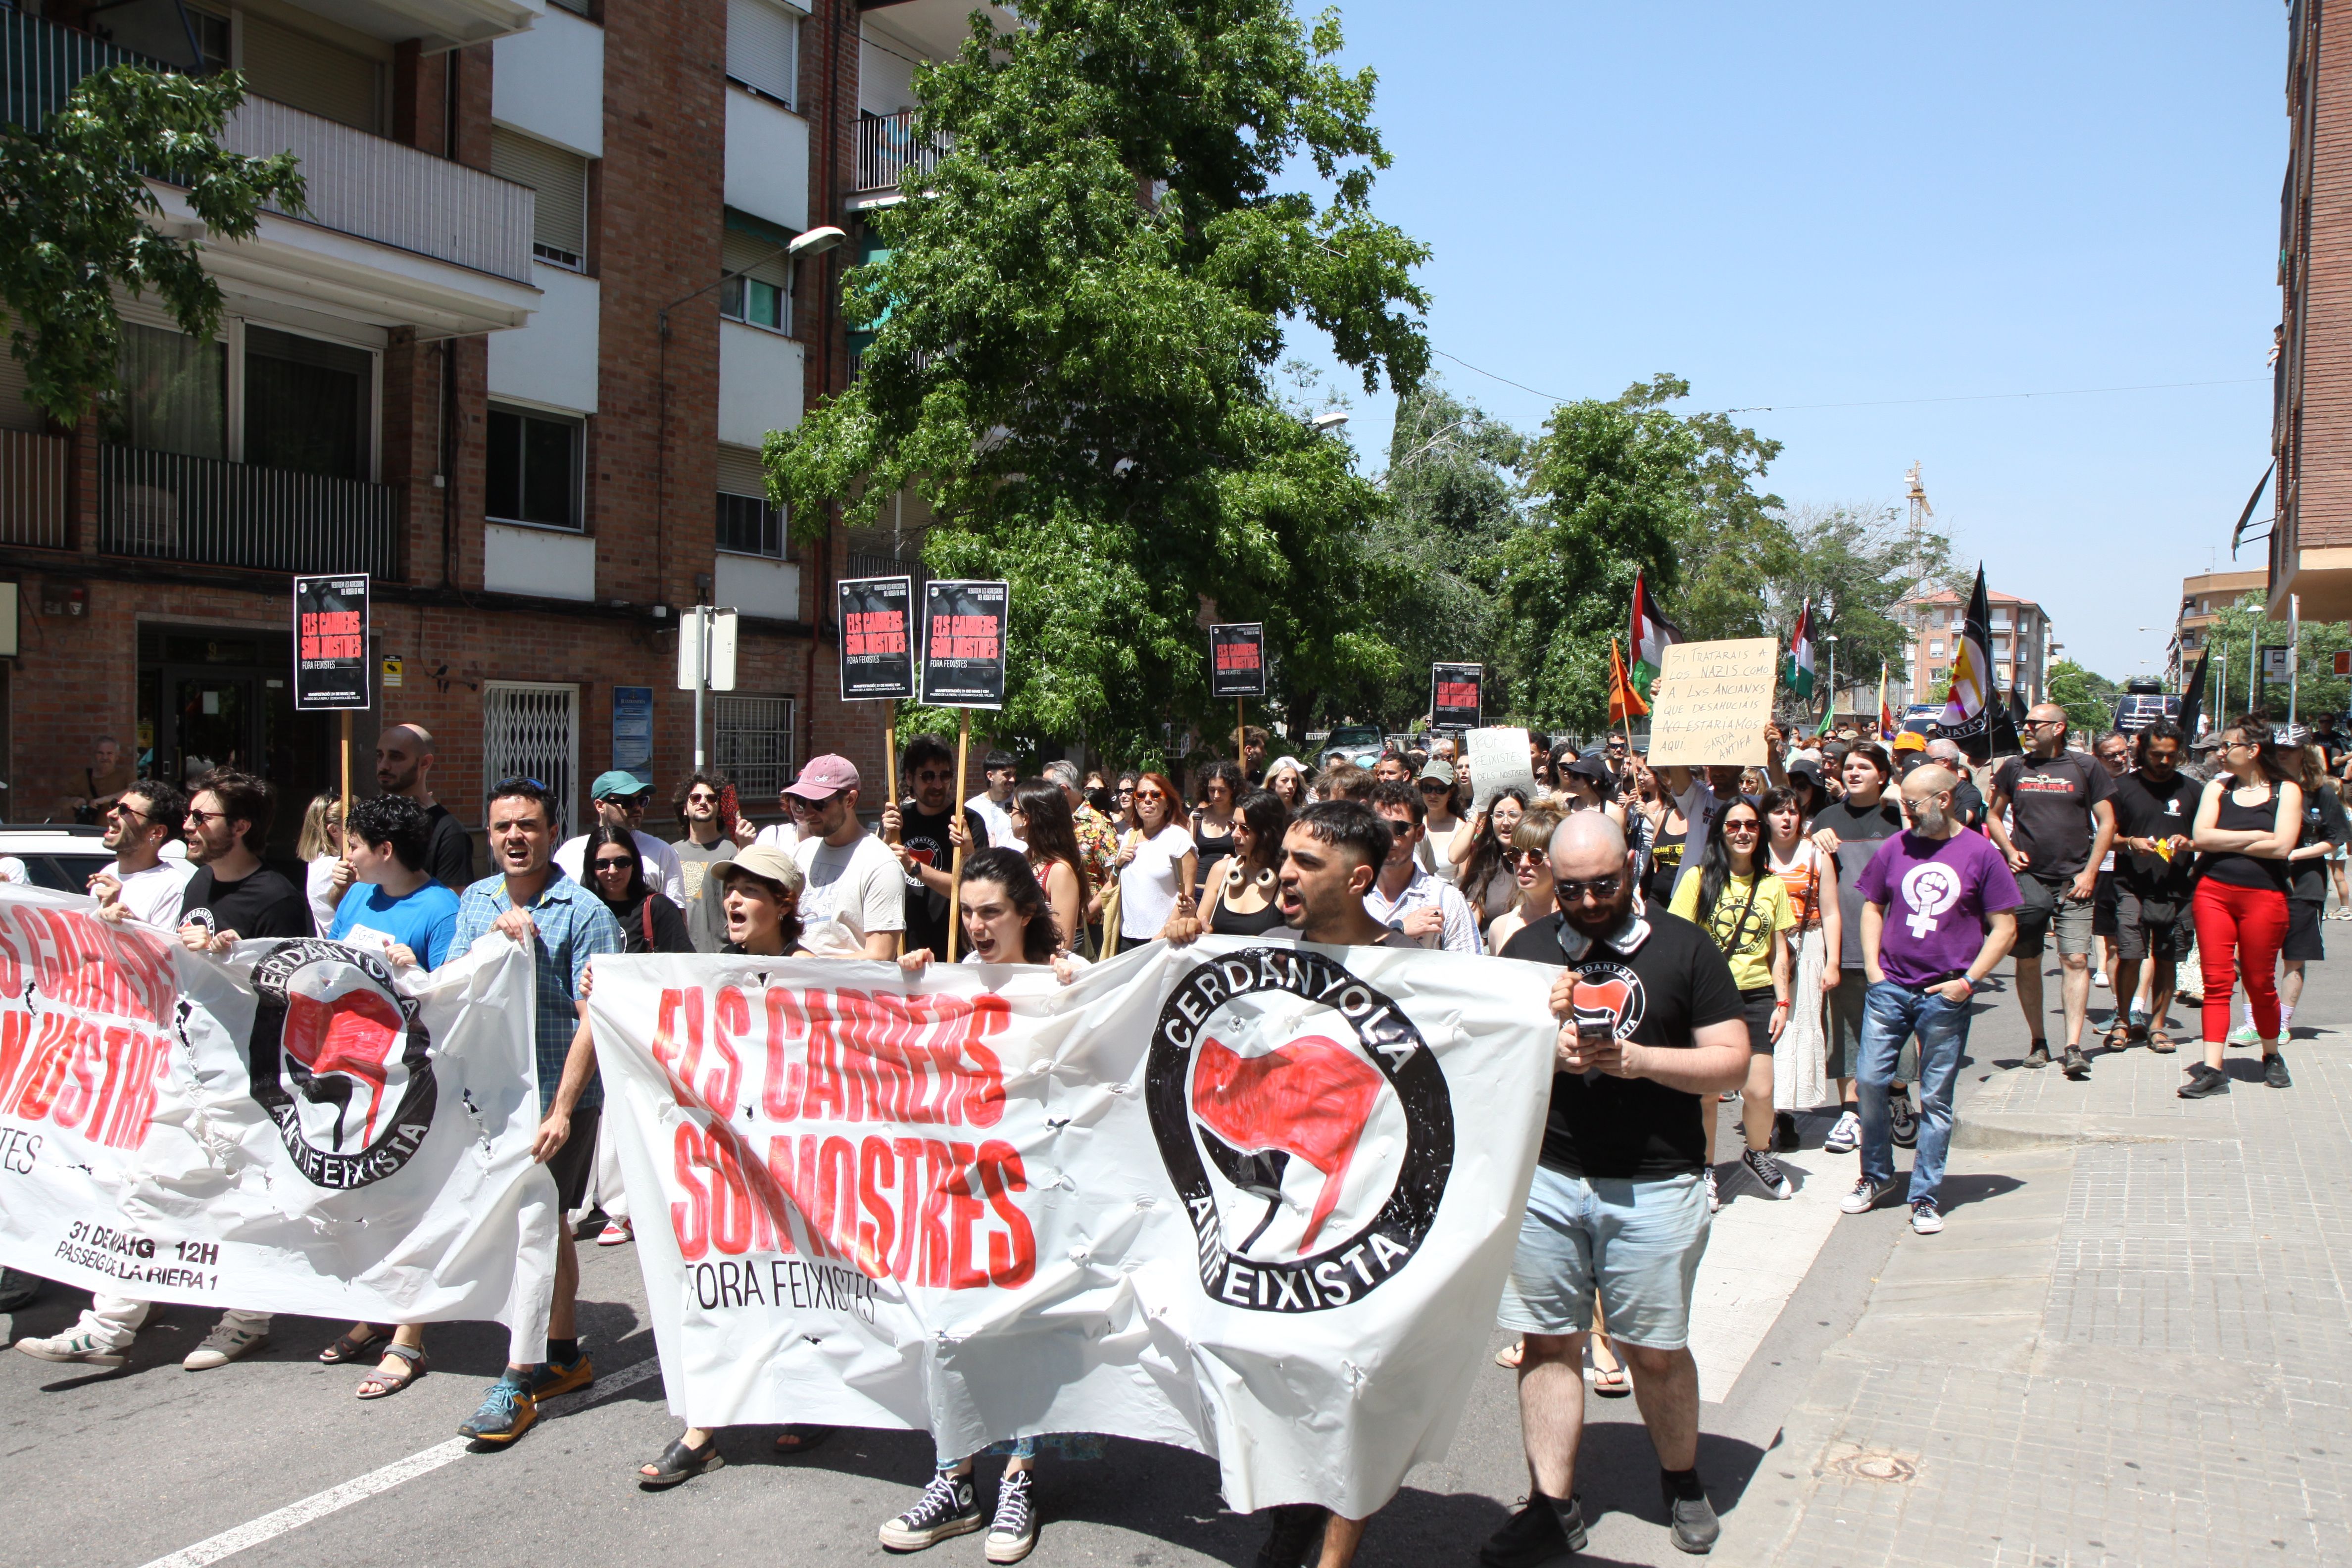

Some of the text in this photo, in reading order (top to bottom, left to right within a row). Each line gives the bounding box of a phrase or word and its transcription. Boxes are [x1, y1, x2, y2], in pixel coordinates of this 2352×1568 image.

[302, 611, 360, 636] ELS CARRERS
[846, 611, 903, 634] ELS CARRERS
[933, 615, 998, 637] ELS CARRERS
[321, 635, 362, 659] NOSTRES
[866, 632, 906, 654] NOSTRES
[953, 637, 998, 659] NOSTRES
[1217, 643, 1258, 657] ELS CARRERS
[302, 660, 336, 670] FORA FEIXISTES
[847, 655, 880, 664] FORA FEIXISTES
[944, 660, 967, 668] FEIXISTES
[1231, 656, 1259, 669] NOSTRES
[1671, 646, 1768, 665] SI TRATARAIS A
[1669, 664, 1769, 681] LOS NAZIS COMO
[1438, 682, 1448, 693] ELS
[1667, 686, 1675, 699] A
[1713, 683, 1766, 695] ANCIANXS
[1664, 696, 1761, 716] QUE DESAHUCIÁIS
[1662, 716, 1761, 734] NO ESTARÍAMOS
[1704, 732, 1735, 755] SARDA
[1719, 735, 1752, 761] ANTIFA
[1474, 752, 1522, 767] FEIXISTES
[1477, 770, 1527, 782] DELS NOSTRES
[905, 838, 939, 853] ERDANYOLA
[260, 942, 418, 1021] ERDANYOA
[1577, 964, 1638, 987] RDANYOLA
[1165, 958, 1417, 1074] CERDANYOLA
[652, 985, 1012, 1129] ELS CARRERS
[273, 1105, 429, 1188] ANTIFEIXISTA
[769, 1133, 1037, 1290] NOSTRES
[69, 1221, 219, 1265] 31 DE MAIG 12H
[54, 1240, 218, 1290] PASSEIG DE LA RIERA 1
[772, 1261, 878, 1324] FEIXISTES
